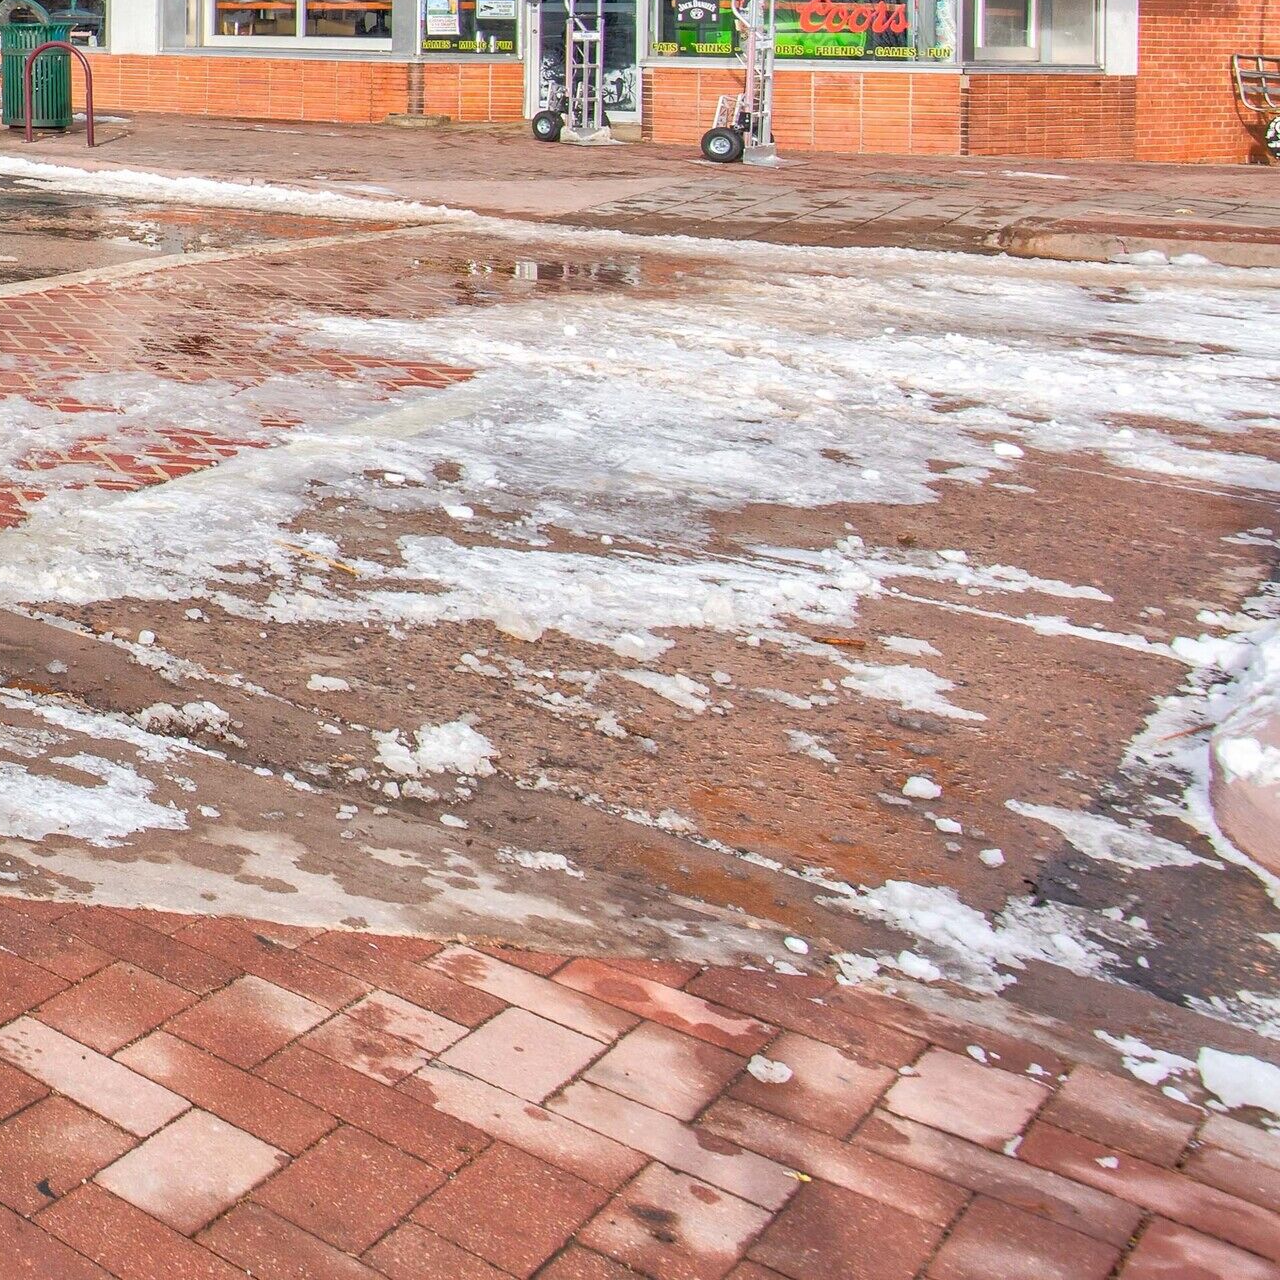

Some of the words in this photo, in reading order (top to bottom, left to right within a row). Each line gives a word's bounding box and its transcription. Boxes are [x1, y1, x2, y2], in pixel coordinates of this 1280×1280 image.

[678, 1, 693, 13] JACK
[495, 40, 513, 49] FUN
[775, 44, 804, 55] ORTS
[816, 46, 864, 57] FRIENDS
[875, 46, 917, 58] GAMES
[928, 47, 952, 58] FUN
